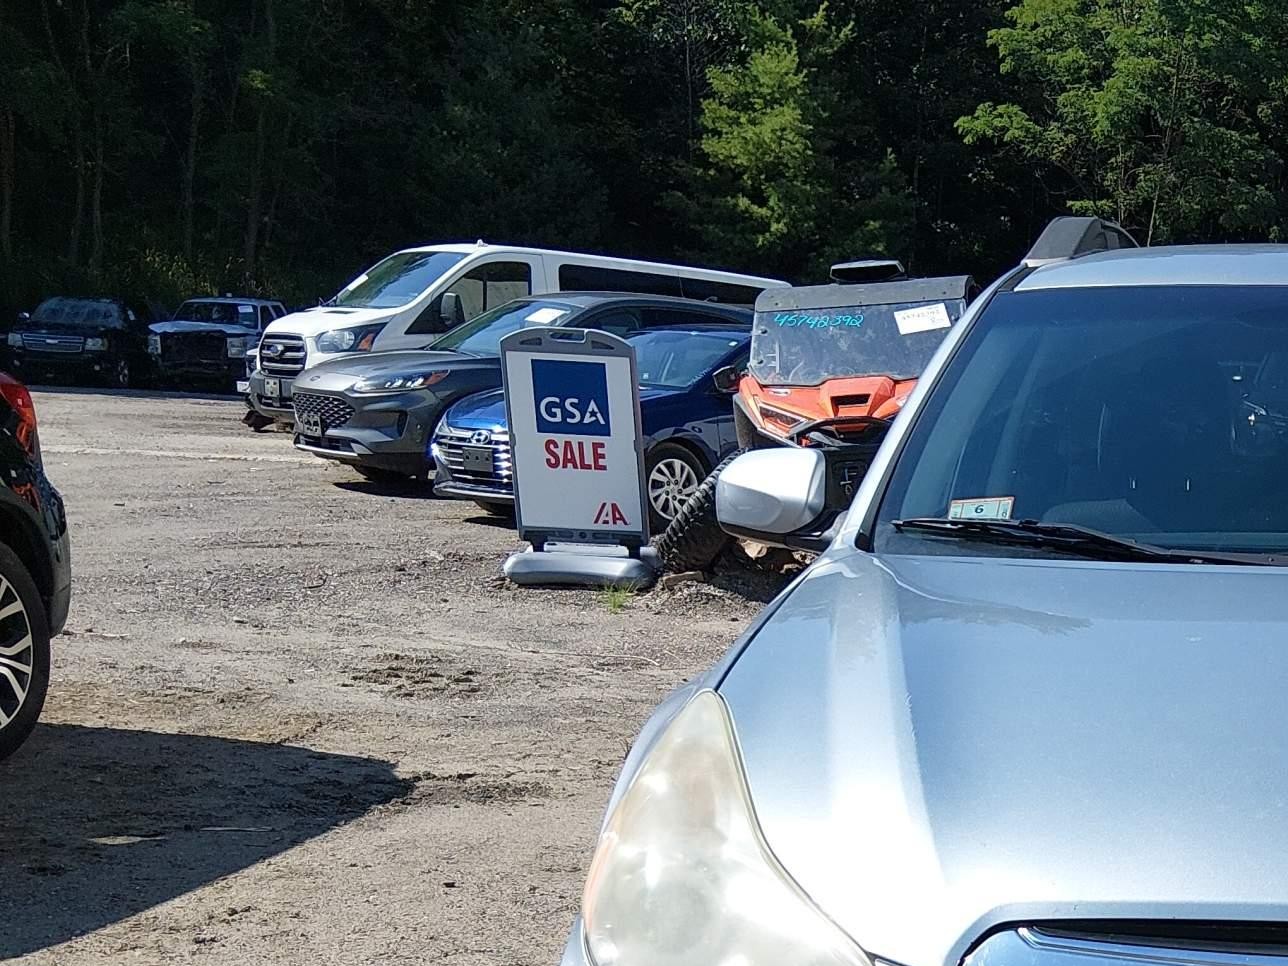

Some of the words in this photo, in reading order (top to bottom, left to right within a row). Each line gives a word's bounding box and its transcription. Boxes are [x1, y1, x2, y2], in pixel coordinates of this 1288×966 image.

[773, 312, 864, 330] 45742392
[539, 396, 606, 426] GSA
[544, 438, 609, 471] SALE
